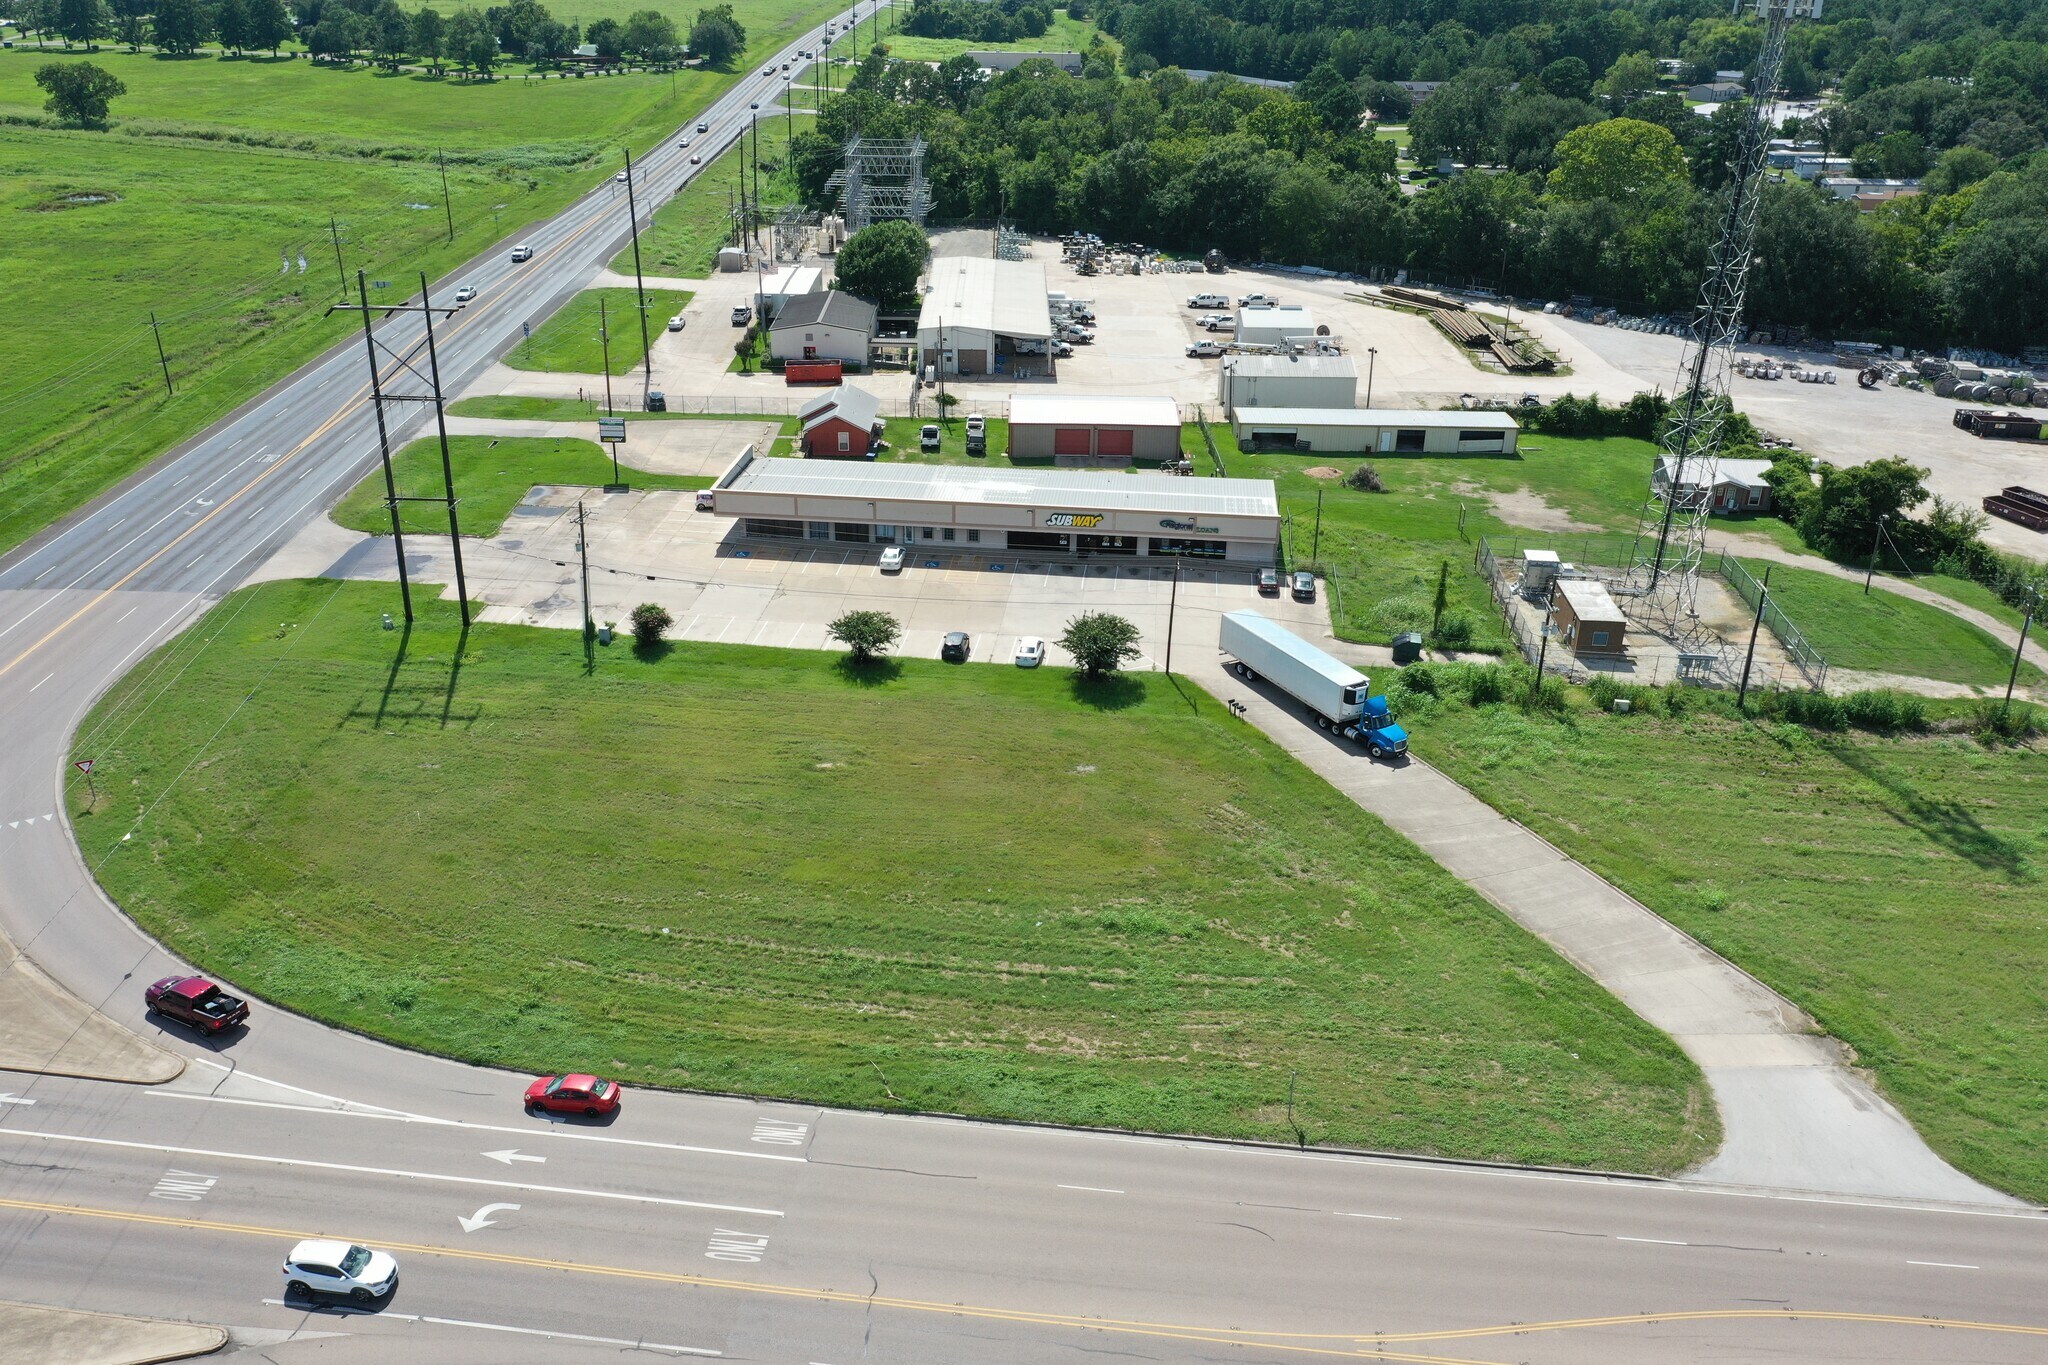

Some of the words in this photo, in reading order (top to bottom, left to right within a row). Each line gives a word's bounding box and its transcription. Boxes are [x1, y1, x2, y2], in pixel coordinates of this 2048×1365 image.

[1046, 513, 1104, 527] SUBWAY
[750, 1116, 809, 1146] ONLY
[148, 1168, 220, 1202] ONLY
[704, 1227, 770, 1263] ONLY
